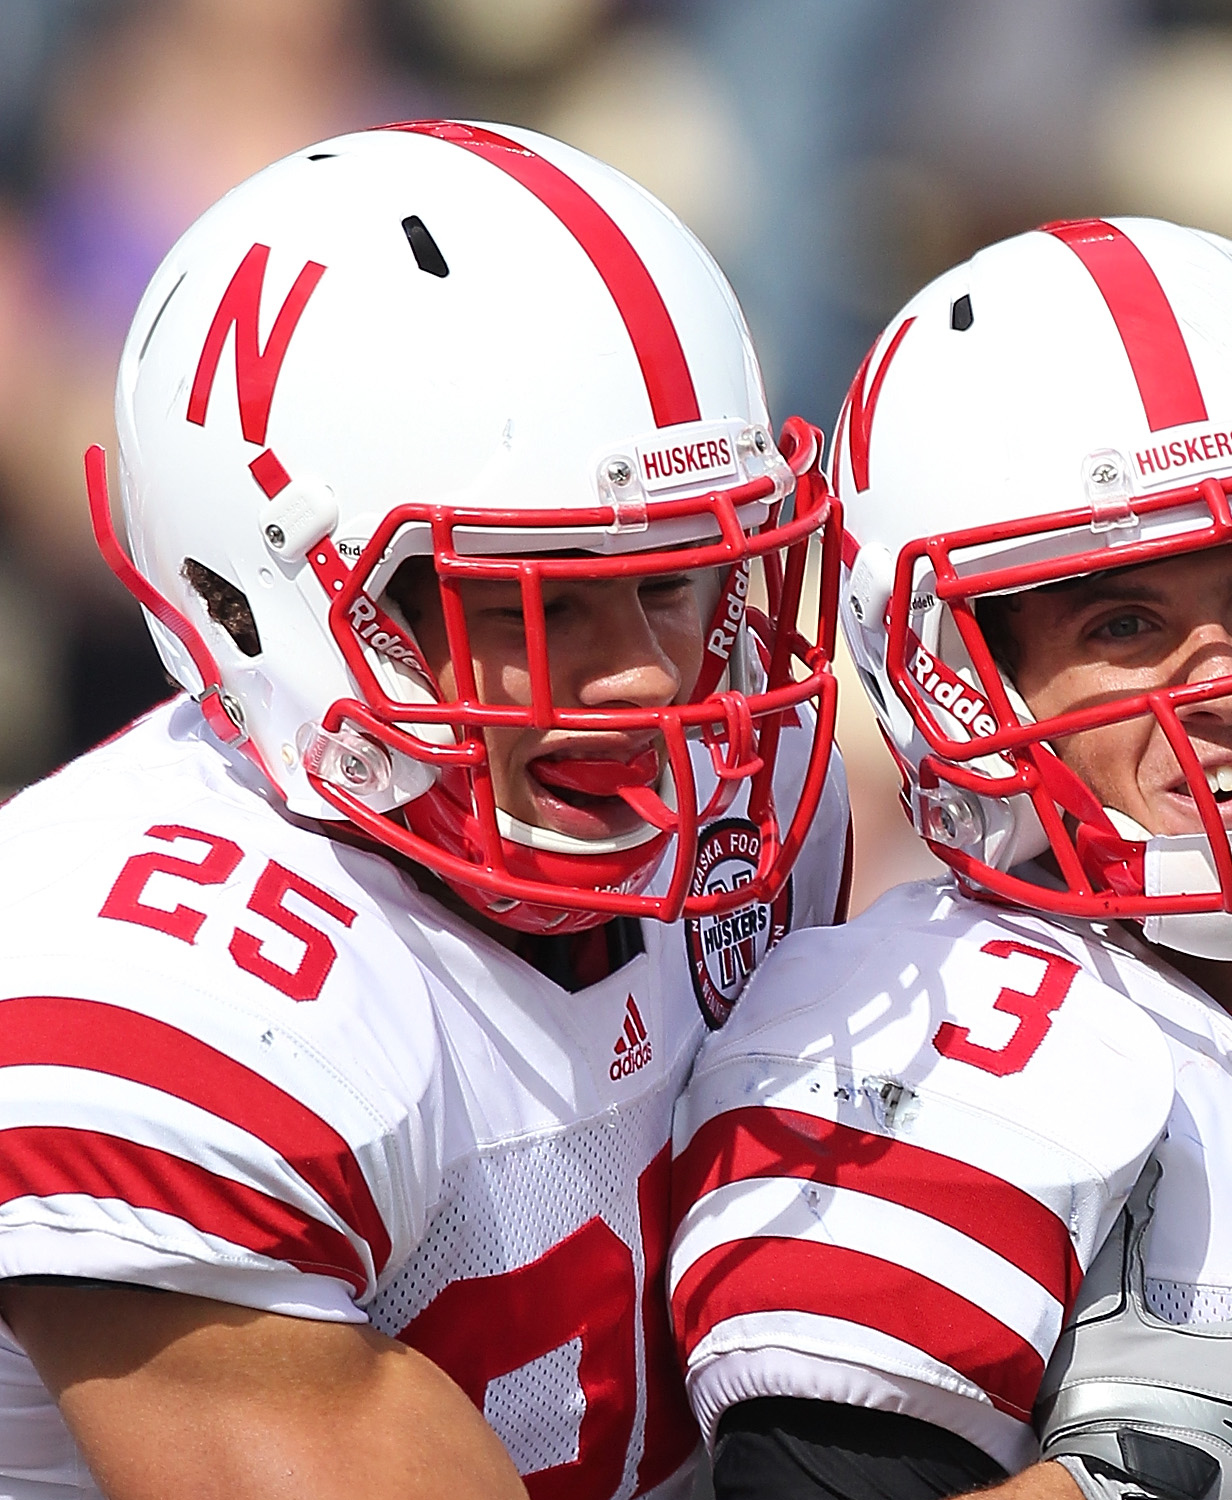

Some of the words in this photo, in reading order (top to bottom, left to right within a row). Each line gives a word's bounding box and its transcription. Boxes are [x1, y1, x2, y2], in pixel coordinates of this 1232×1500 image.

[187, 243, 328, 446] N
[832, 316, 918, 498] N
[643, 438, 731, 480] HUSKERS
[349, 596, 428, 676] Ridde
[708, 559, 751, 660] Ridd
[911, 647, 999, 738] Ridde
[98, 824, 358, 1002] 25
[703, 906, 767, 955] HUSKERS
[933, 939, 1082, 1077] 3
